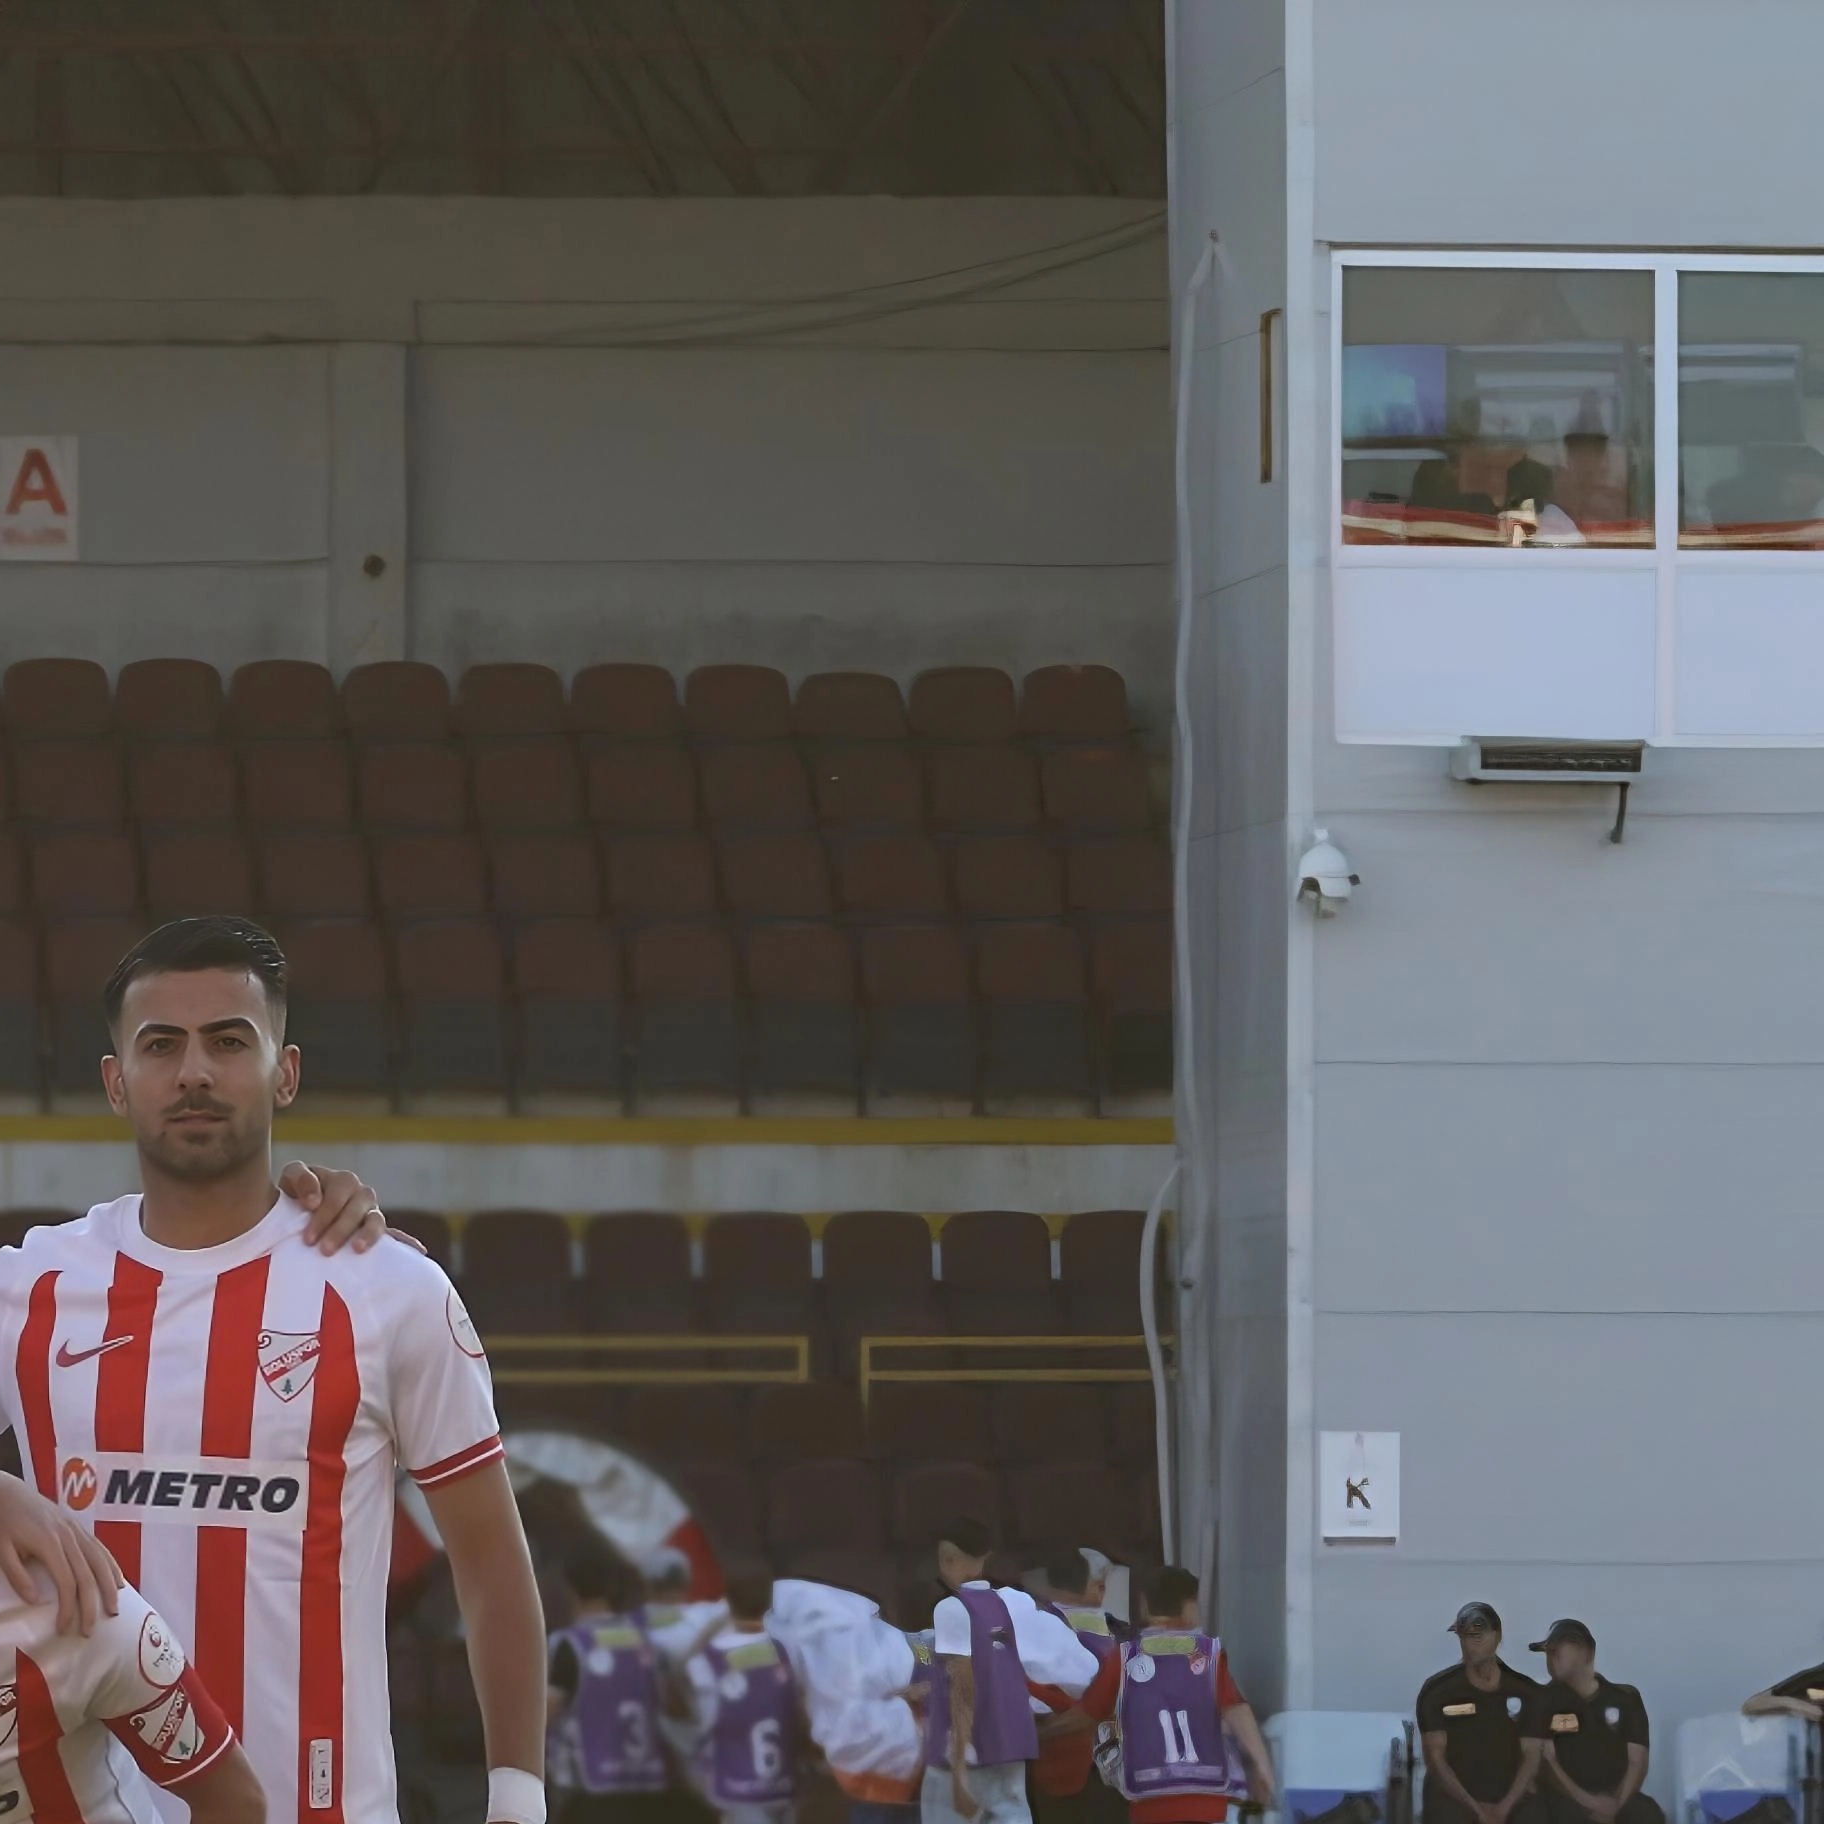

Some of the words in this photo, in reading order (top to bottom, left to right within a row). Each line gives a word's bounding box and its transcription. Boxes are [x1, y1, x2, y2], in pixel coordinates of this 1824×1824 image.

[5, 448, 69, 517] A
[103, 1469, 300, 1513] METRO
[751, 1717, 782, 1779] 6
[1158, 1709, 1200, 1764] 11
